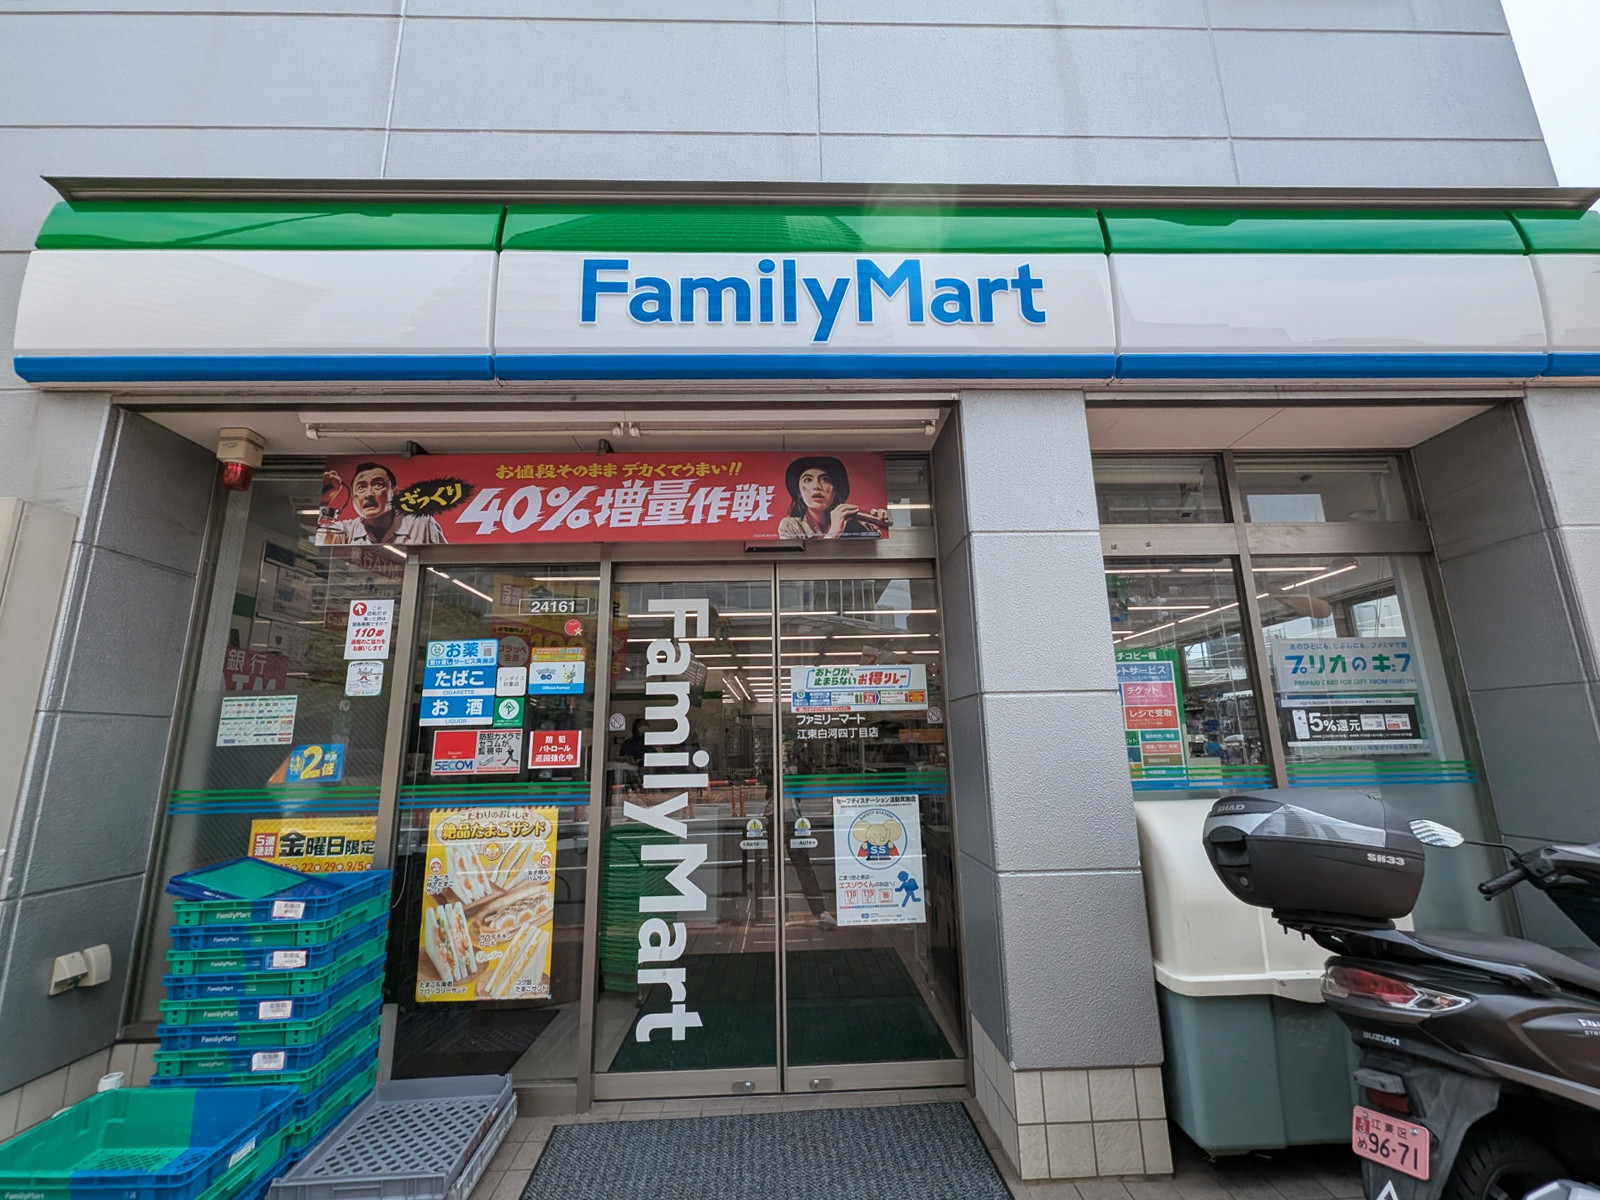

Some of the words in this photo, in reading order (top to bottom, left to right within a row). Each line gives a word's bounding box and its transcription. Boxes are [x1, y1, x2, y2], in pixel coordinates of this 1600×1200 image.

[580, 258, 1047, 343] FamilyMart
[495, 463, 618, 480] お値段そのまま
[400, 482, 464, 513] ざっくり
[455, 478, 777, 535] 40%増量作戦
[531, 600, 575, 613] 24161
[354, 627, 384, 638] 110番
[446, 641, 480, 658] お薬
[1115, 651, 1157, 660] チコピー機
[226, 649, 267, 675] 銀行
[434, 670, 485, 687] たばこ
[540, 673, 553, 681] GO
[814, 676, 857, 686] 止まらない
[858, 671, 907, 686] お得リレー
[1294, 679, 1321, 687] PREPAID
[1127, 685, 1159, 695] チケット
[796, 713, 866, 725] ファミリーマート
[1308, 712, 1361, 732] 5%還元
[479, 732, 521, 741] 防犯カメラで
[796, 727, 879, 739] 江東白河四丁目店
[479, 740, 509, 748] セコムが
[545, 735, 566, 744] 防犯
[478, 747, 503, 756] 監視中
[539, 745, 571, 753] パトロール
[535, 754, 574, 763] 巡回強化中
[434, 760, 473, 771] SECOM
[1216, 803, 1246, 812] SHAD
[459, 810, 529, 822] こだわりのおいしさ
[623, 598, 710, 1042] FamilyMart
[441, 820, 547, 841] 絶品たまごサンド
[256, 834, 276, 846] 5週
[279, 830, 376, 857] 金曜日限定
[254, 845, 275, 857] 連続
[870, 846, 887, 855] SS
[1366, 853, 1406, 866] SH33
[216, 911, 252, 920] FamilyMart
[515, 984, 548, 993] たまごサンド
[201, 1035, 237, 1044] FamilyMart
[1362, 1031, 1401, 1046] SUZUKI
[1371, 1117, 1408, 1140] 江東区
[1357, 1137, 1368, 1150] め
[1368, 1132, 1419, 1171] 96-71
